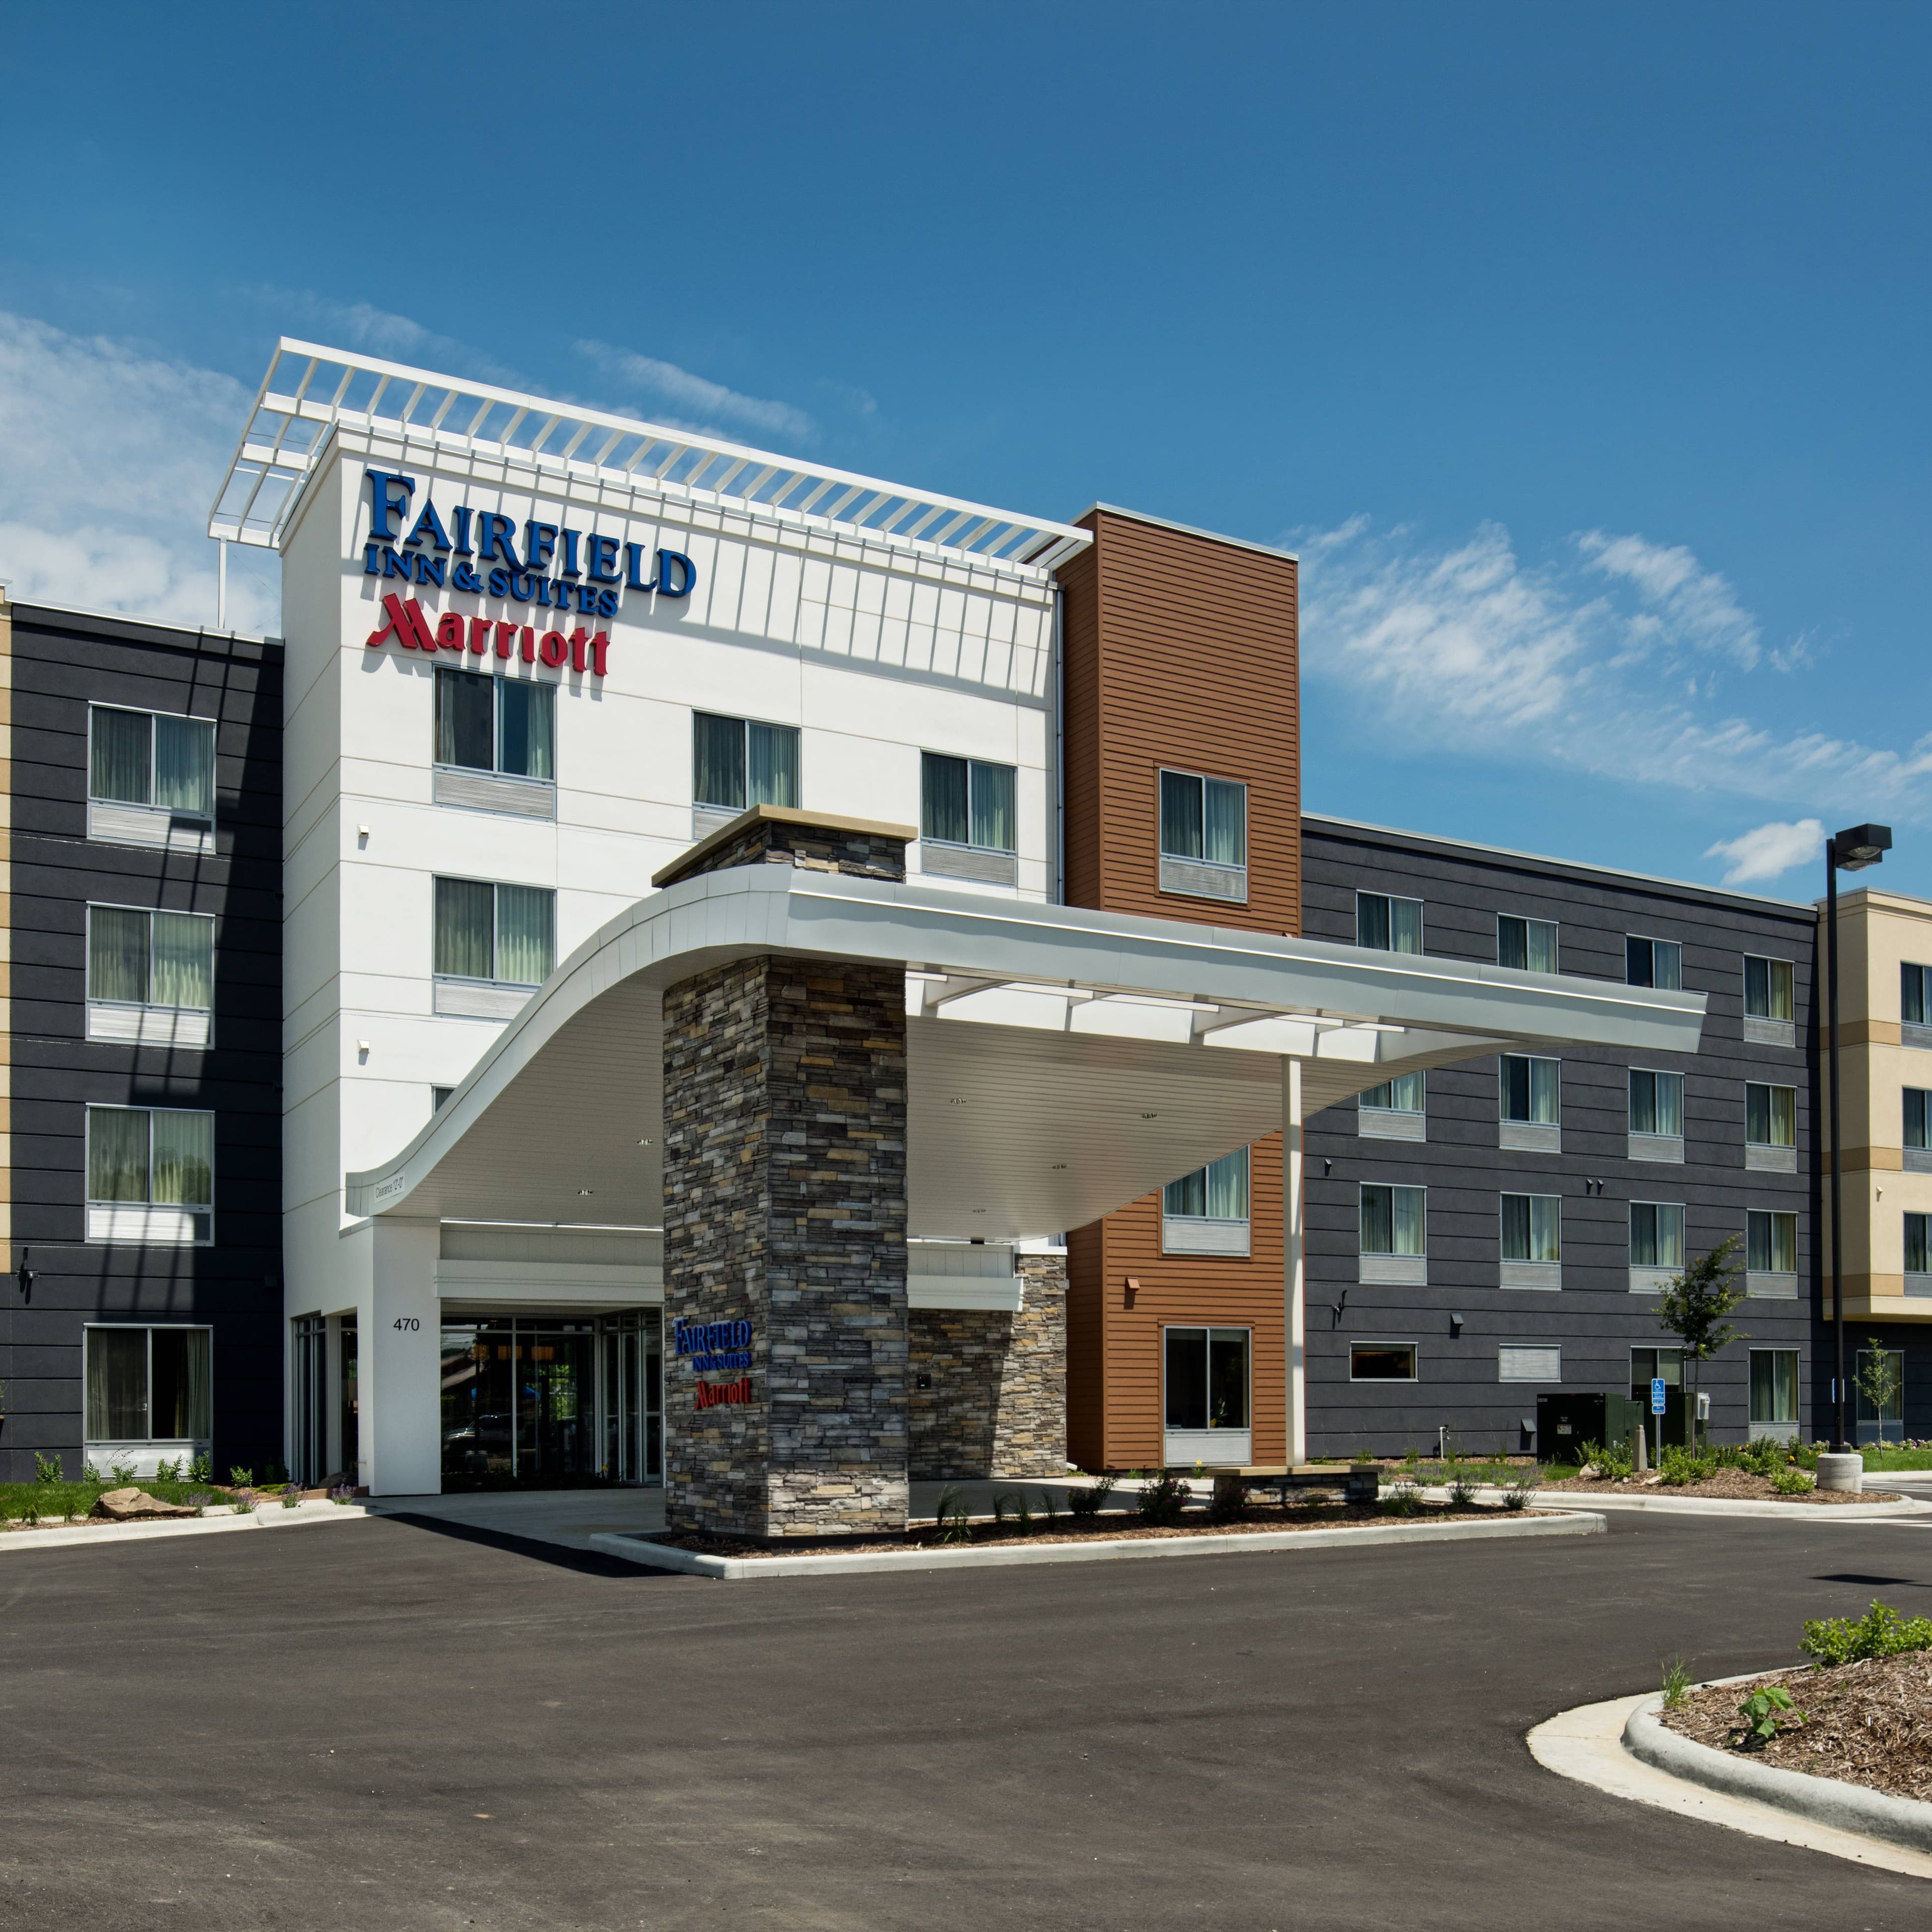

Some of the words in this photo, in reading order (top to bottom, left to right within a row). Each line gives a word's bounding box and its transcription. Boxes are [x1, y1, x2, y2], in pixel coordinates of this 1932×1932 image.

[365, 468, 697, 598] FAIRFIELD
[366, 592, 610, 676] Marriott
[376, 1184, 392, 1197] Clearance
[393, 1318, 420, 1331] 470
[674, 1319, 752, 1354] FAIRFIELD
[694, 1378, 751, 1410] Marriott
